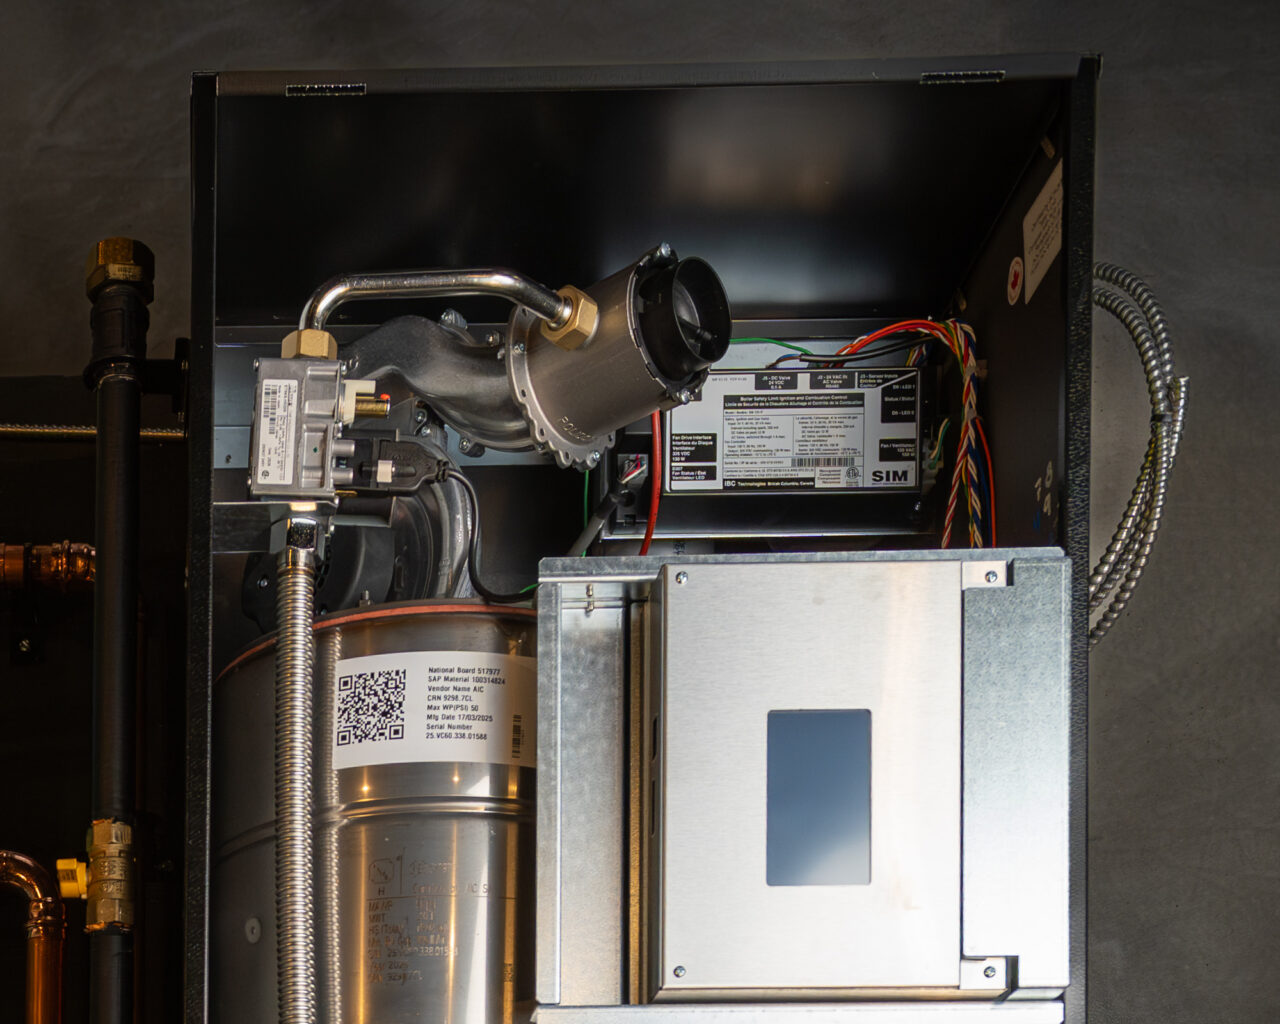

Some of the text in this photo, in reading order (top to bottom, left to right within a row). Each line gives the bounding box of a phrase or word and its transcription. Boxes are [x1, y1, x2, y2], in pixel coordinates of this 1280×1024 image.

[872, 470, 908, 482] SIM
[427, 694, 442, 702] CRN
[442, 704, 468, 712] WP(PSI)
[471, 704, 479, 712] 50
[458, 714, 494, 722] 17/03/2025
